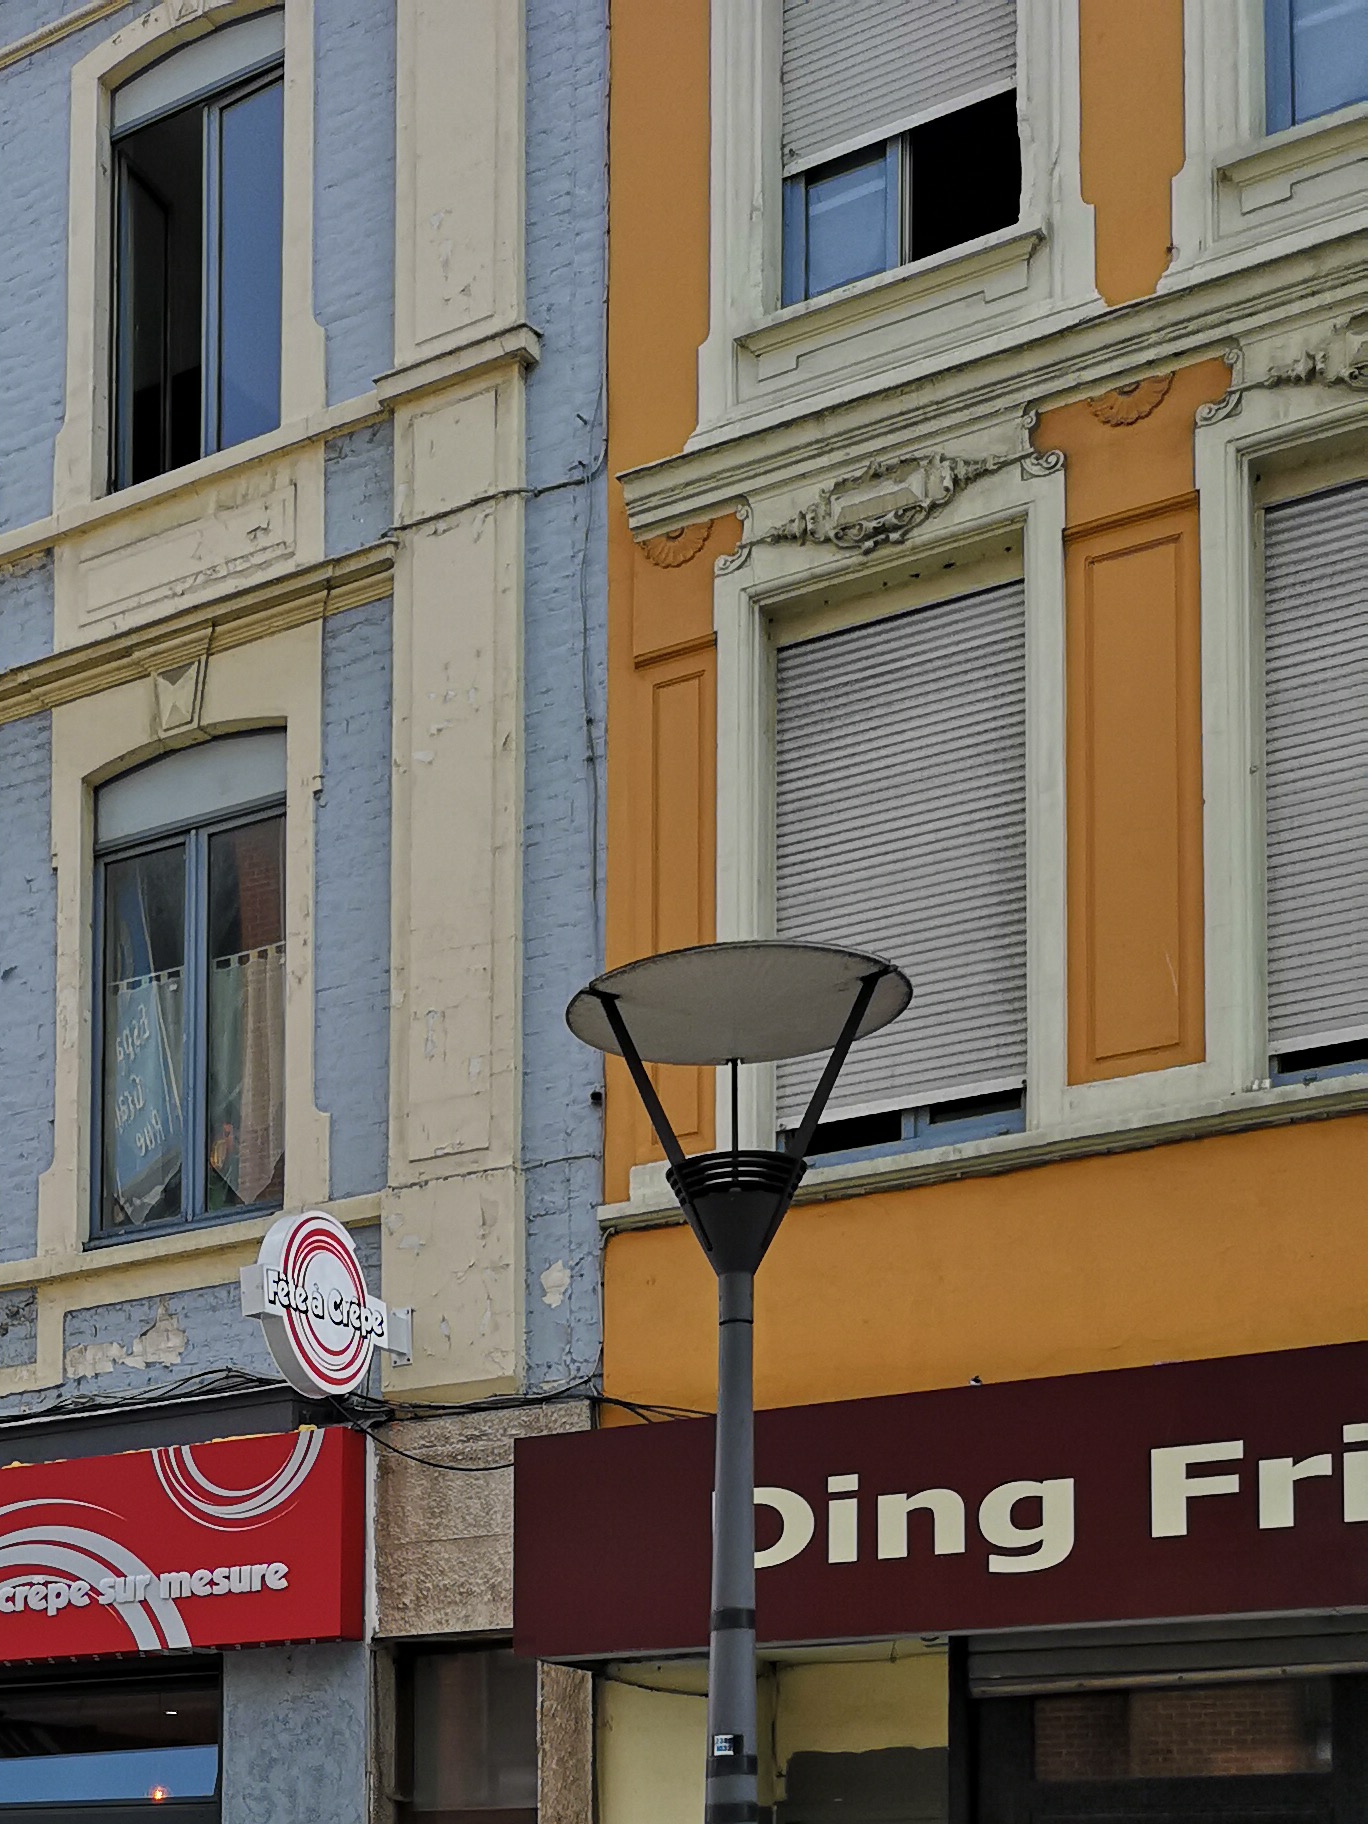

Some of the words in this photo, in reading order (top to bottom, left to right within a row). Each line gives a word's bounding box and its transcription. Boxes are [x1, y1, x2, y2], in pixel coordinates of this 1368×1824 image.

[266, 1268, 309, 1314] Fête
[311, 1283, 325, 1320] à
[327, 1287, 385, 1340] Crêpe
[1149, 1422, 1368, 1539] Fri
[97, 1572, 152, 1606] sur
[159, 1561, 290, 1599] mesure
